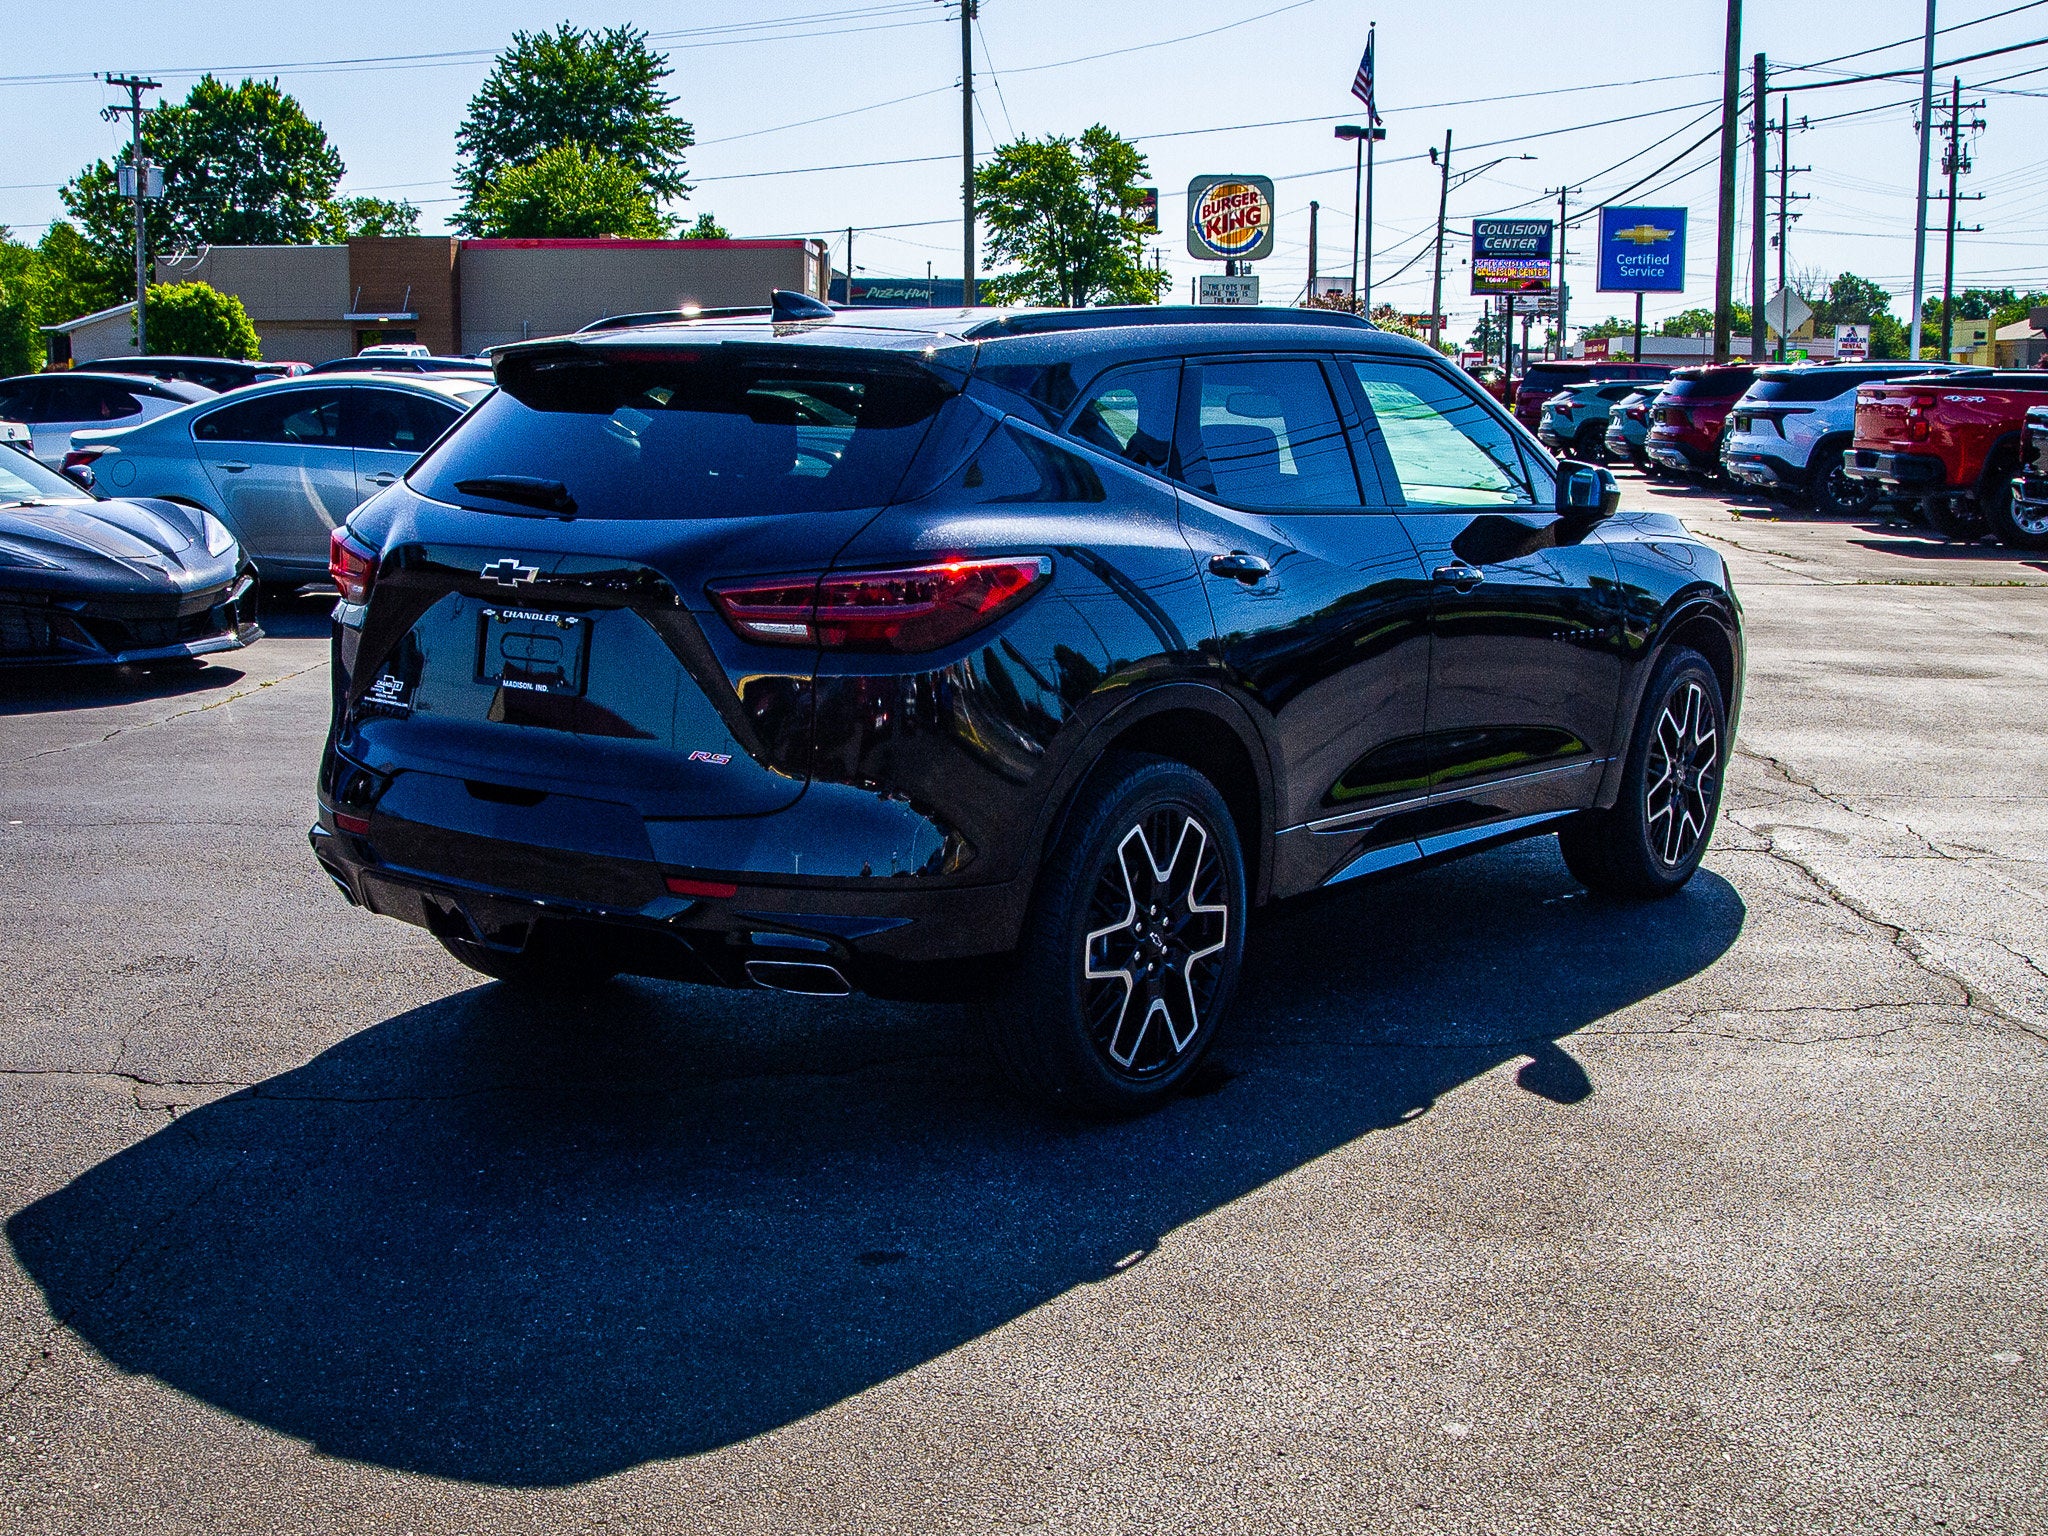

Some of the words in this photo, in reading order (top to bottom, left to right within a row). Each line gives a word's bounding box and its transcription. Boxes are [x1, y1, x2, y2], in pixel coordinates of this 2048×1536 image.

[1203, 191, 1258, 219] BURGER
[1206, 206, 1261, 239] KING
[1478, 223, 1547, 235] COLLISION
[1484, 237, 1537, 249] CENTER
[1616, 253, 1670, 265] Certified
[1519, 268, 1548, 277] CENTER
[1620, 265, 1665, 277] Service
[866, 287, 904, 298] Pizza
[503, 611, 559, 622] CHANDLER
[535, 684, 549, 692] IND.
[688, 751, 732, 764] RS
